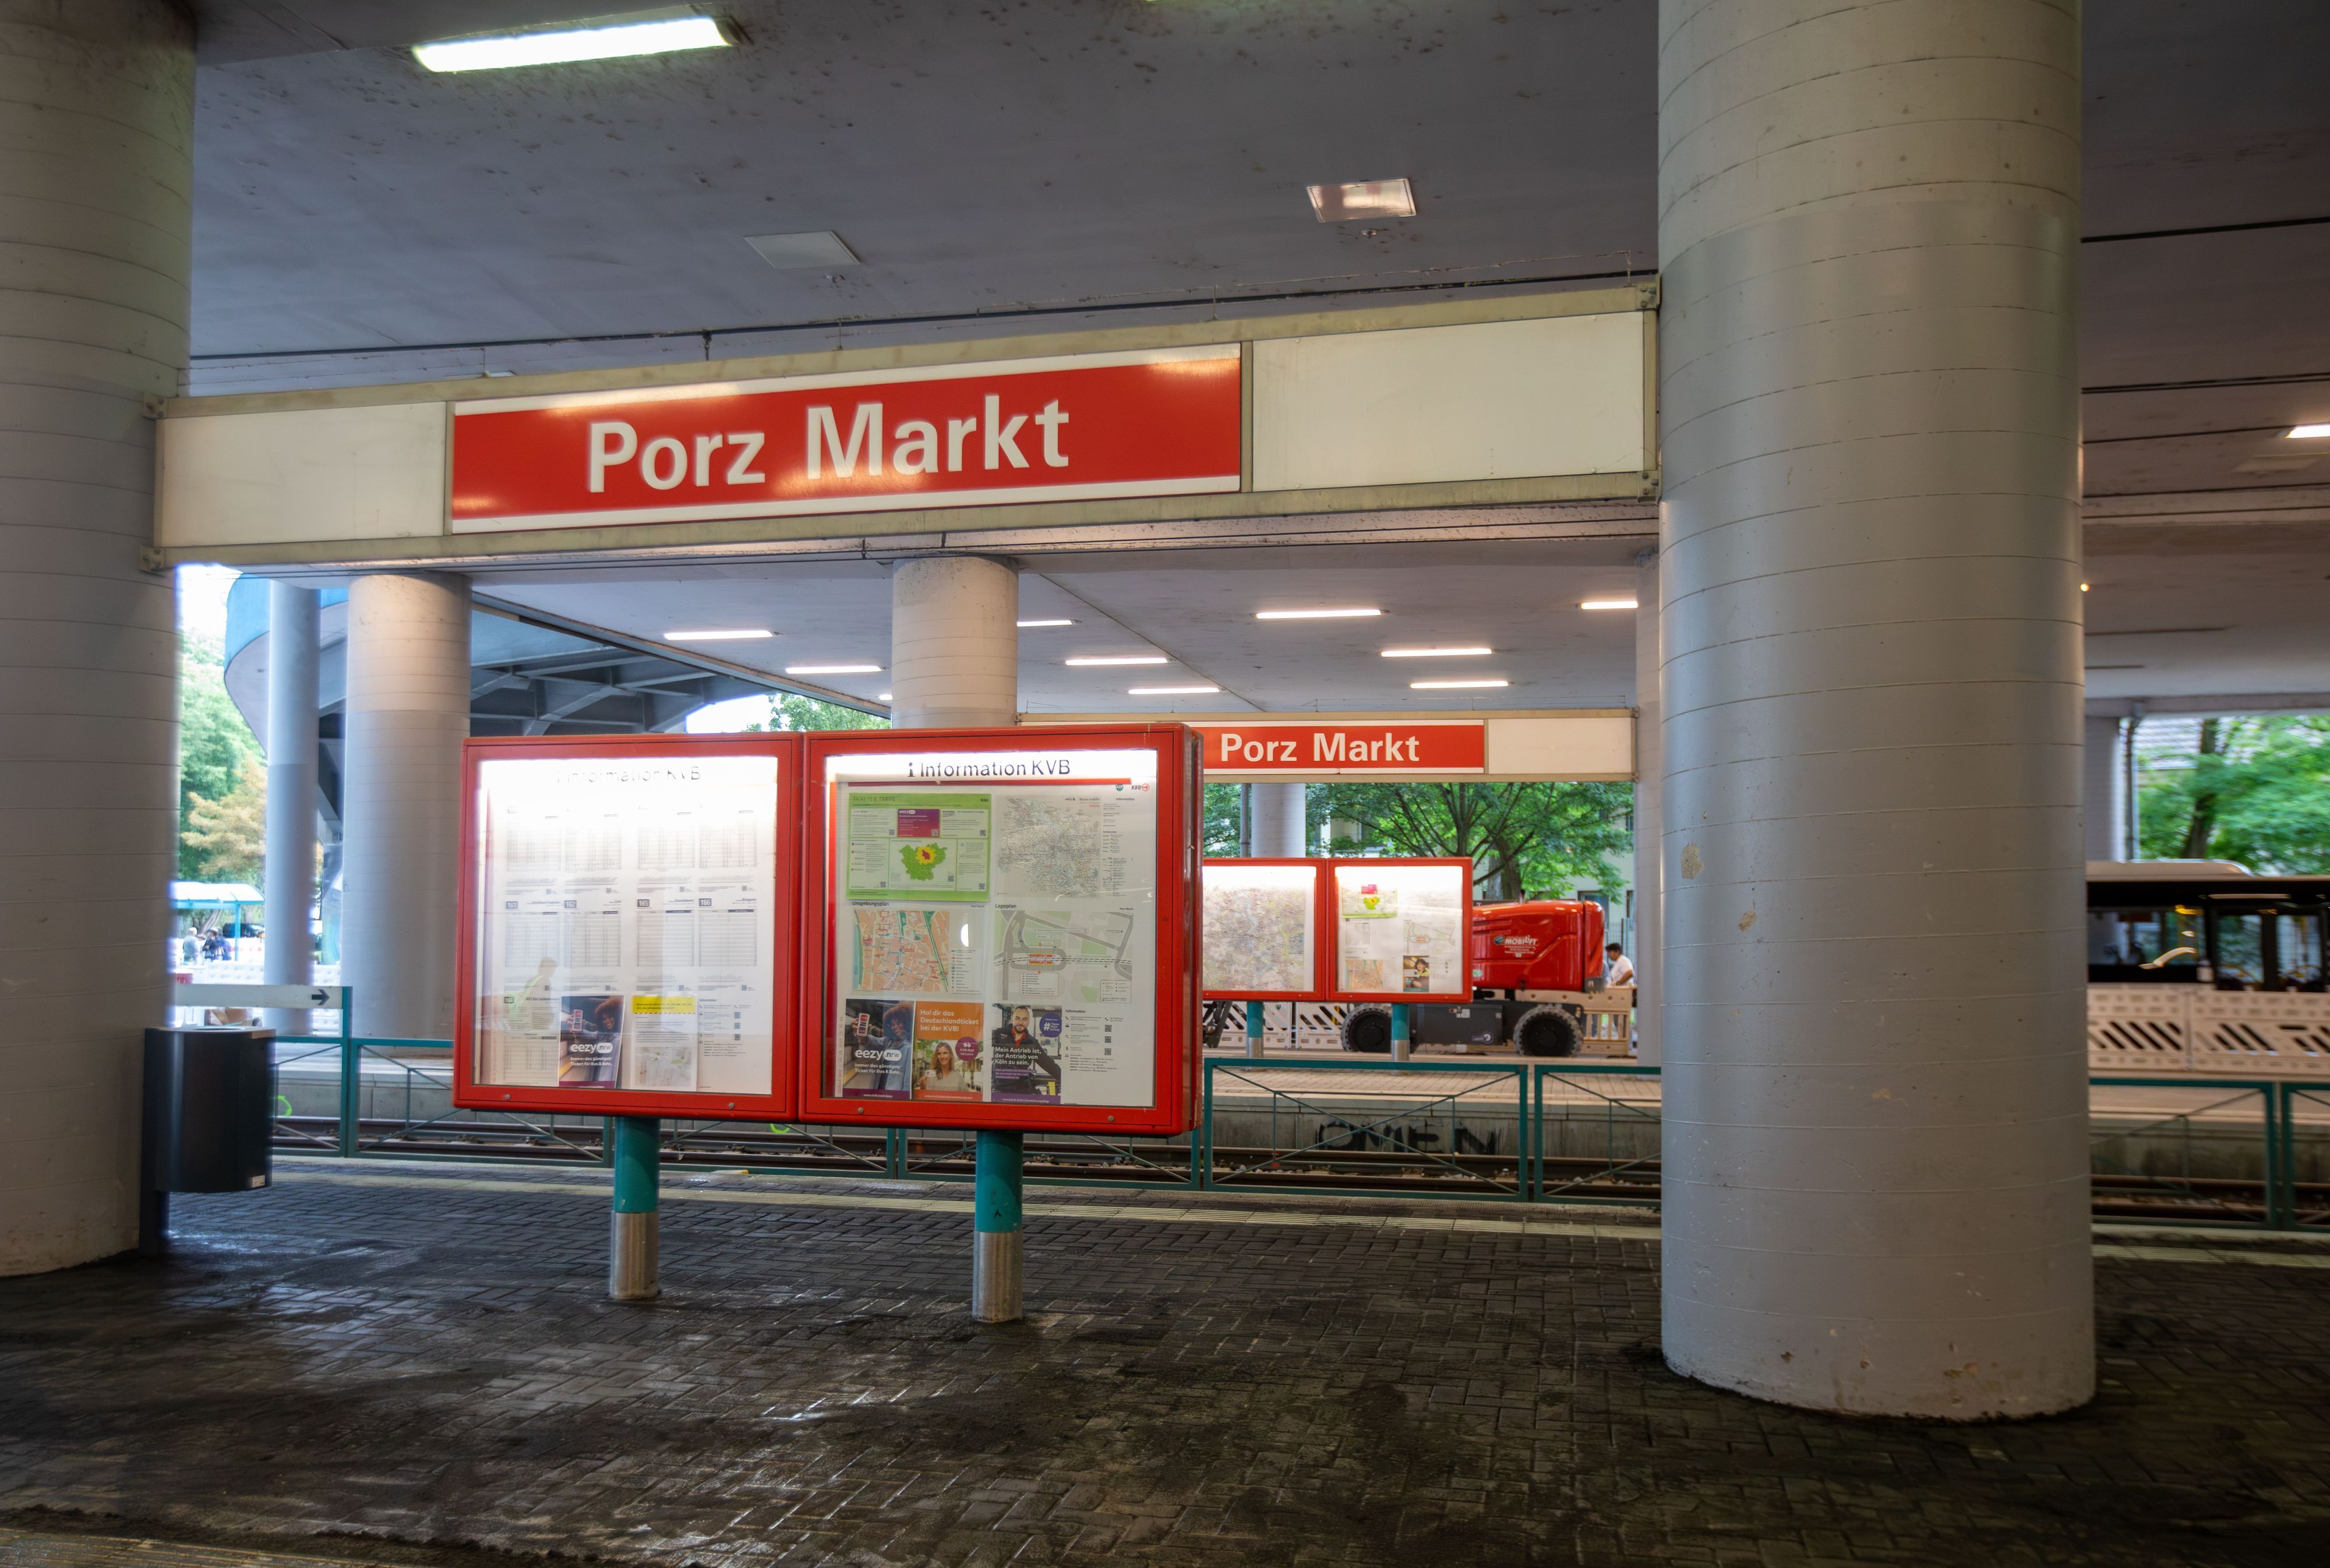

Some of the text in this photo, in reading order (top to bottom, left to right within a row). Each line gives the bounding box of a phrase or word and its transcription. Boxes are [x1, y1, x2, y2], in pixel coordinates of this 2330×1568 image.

[590, 394, 1070, 493] Porz Markt
[1221, 732, 1420, 762] Porz Markt
[566, 768, 661, 783] Inormation
[920, 762, 1026, 778] Information
[1032, 760, 1071, 775] KVB
[855, 1050, 900, 1060] eezy.nrw
